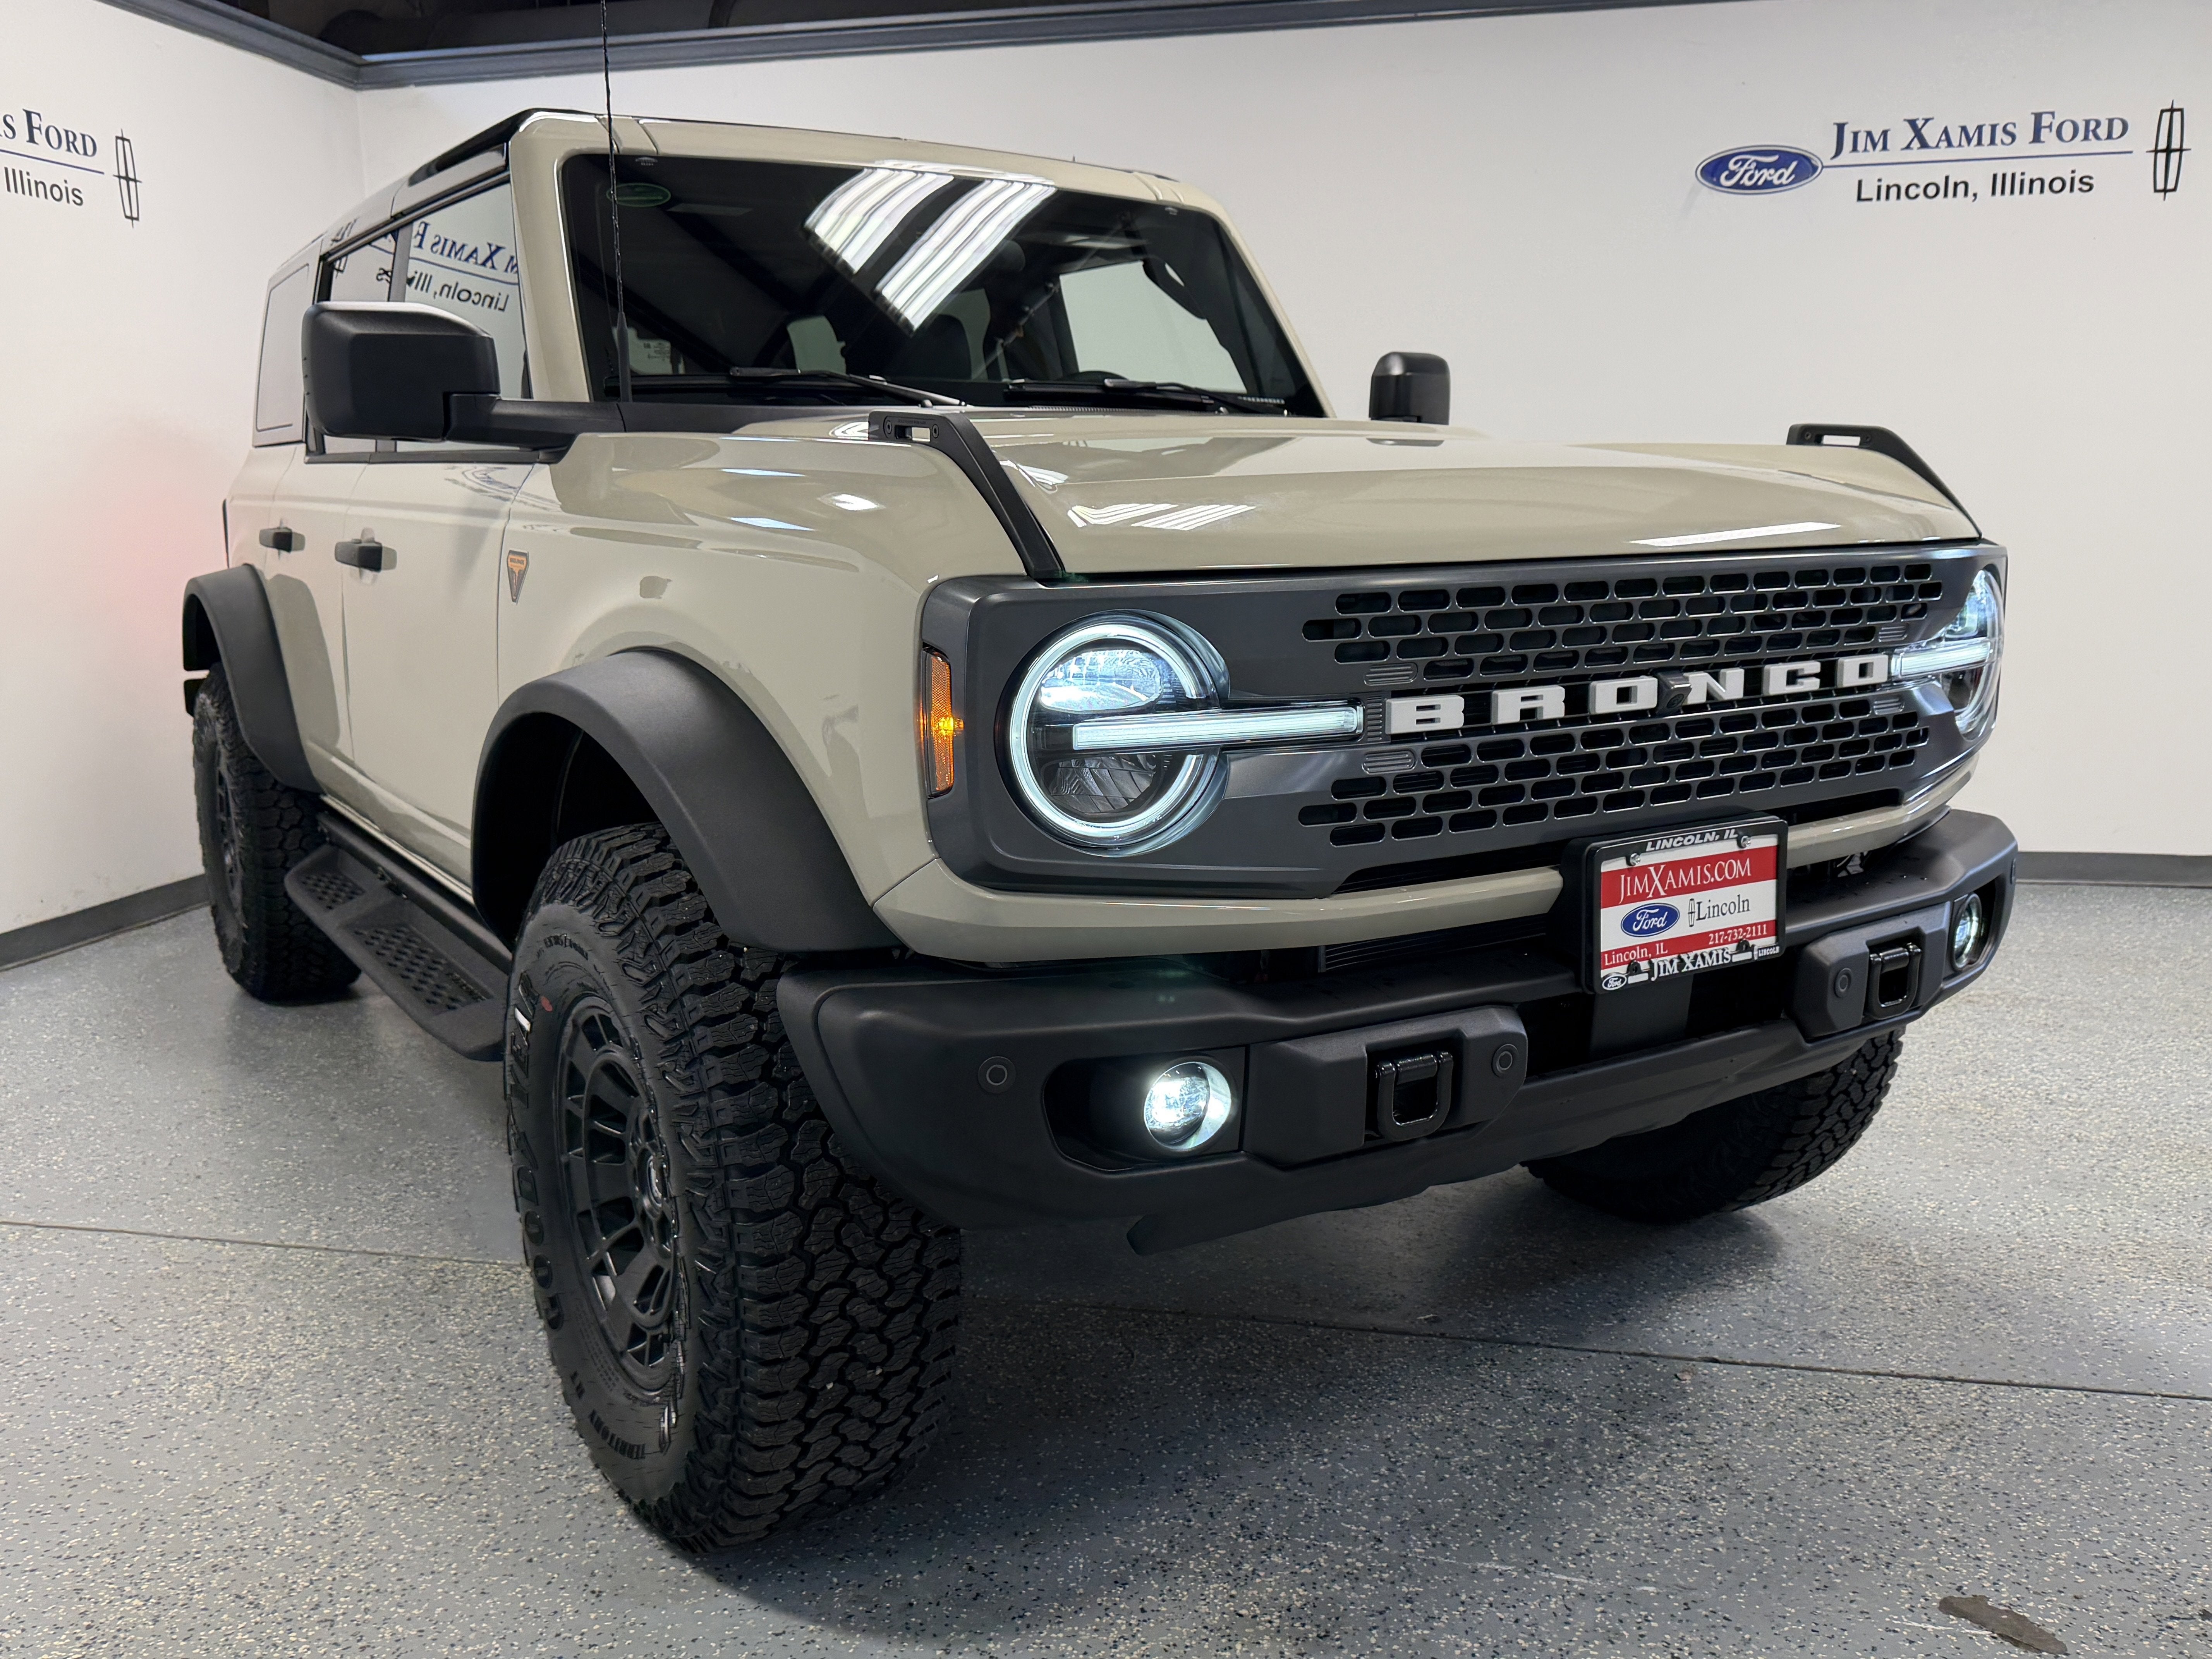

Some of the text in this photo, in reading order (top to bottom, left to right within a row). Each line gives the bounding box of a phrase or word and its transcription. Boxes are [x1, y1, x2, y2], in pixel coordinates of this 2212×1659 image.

[22, 108, 97, 157] FORD
[1830, 110, 2129, 160] JIM XAMIS FORD
[4, 167, 84, 206] Illinois
[1719, 154, 1795, 187] Ford
[1856, 169, 2094, 203] Lincoln, Illinois
[1385, 654, 1890, 735] BRONCO
[1646, 829, 1738, 852] LINCOLN, IL
[1619, 857, 1752, 904] JIMXAMIS.COM
[1632, 908, 1668, 931] Ford
[1696, 895, 1750, 921] Lincoln
[1708, 924, 1767, 945] 217-732-2111
[1605, 943, 1668, 966] Lincoln, IL
[1651, 948, 1732, 982] JIM XAMIS
